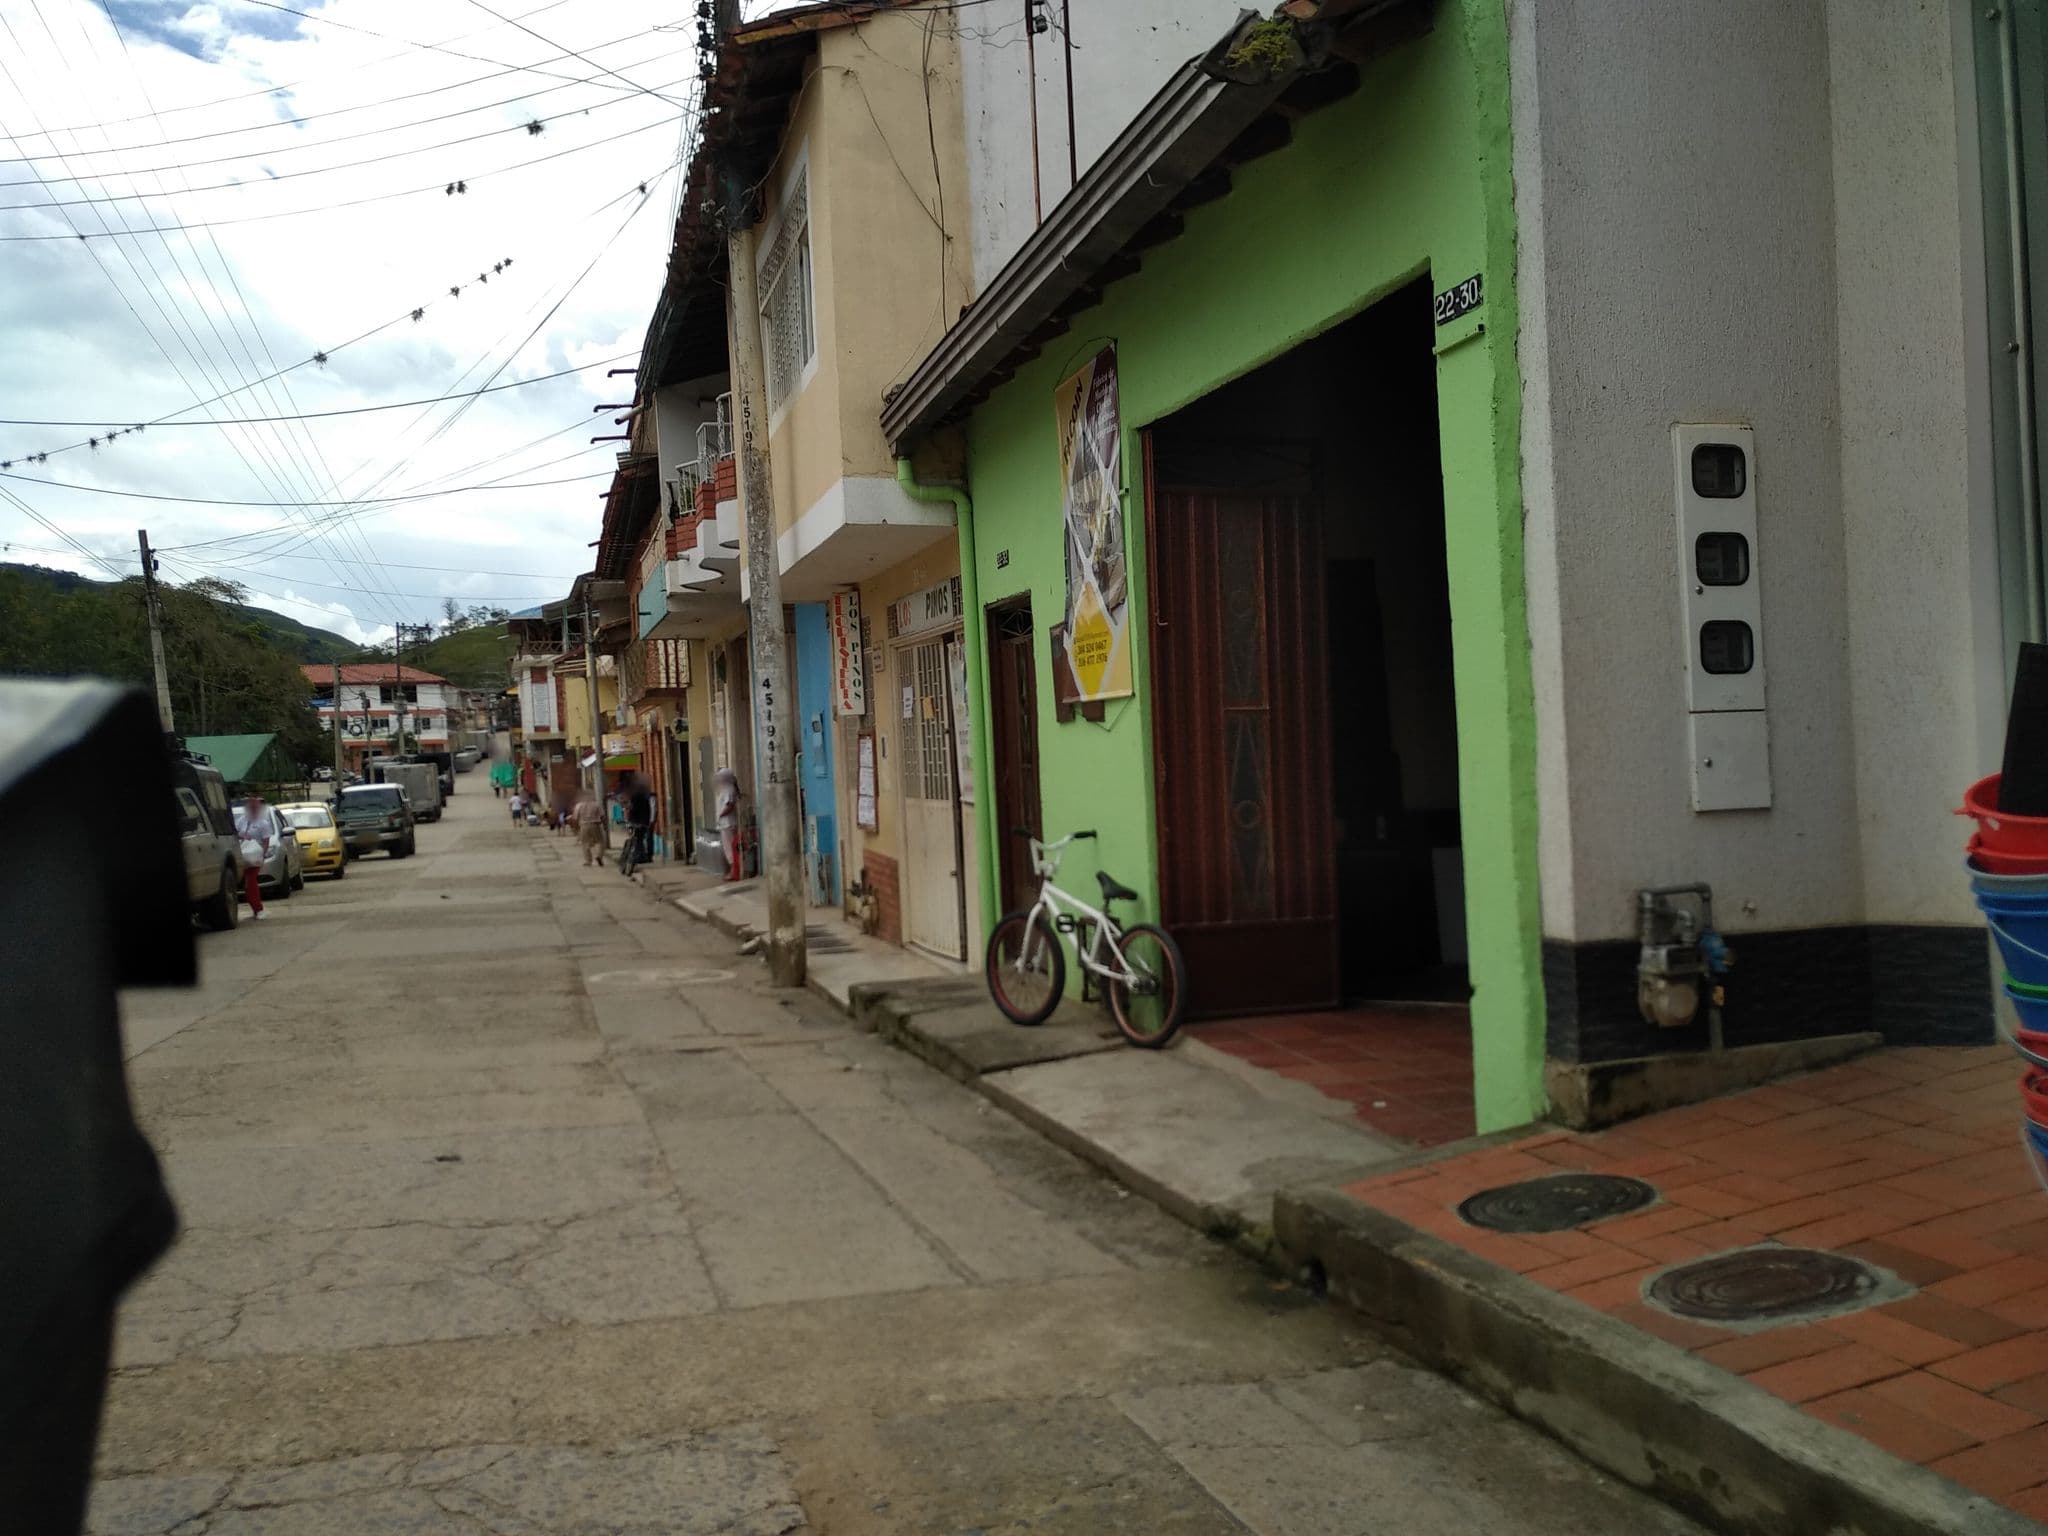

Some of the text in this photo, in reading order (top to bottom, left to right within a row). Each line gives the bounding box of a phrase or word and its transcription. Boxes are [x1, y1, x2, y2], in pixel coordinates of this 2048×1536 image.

[1436, 279, 1478, 321] 22-30
[925, 586, 948, 620] PINOS
[848, 596, 862, 700] LOS PINOS
